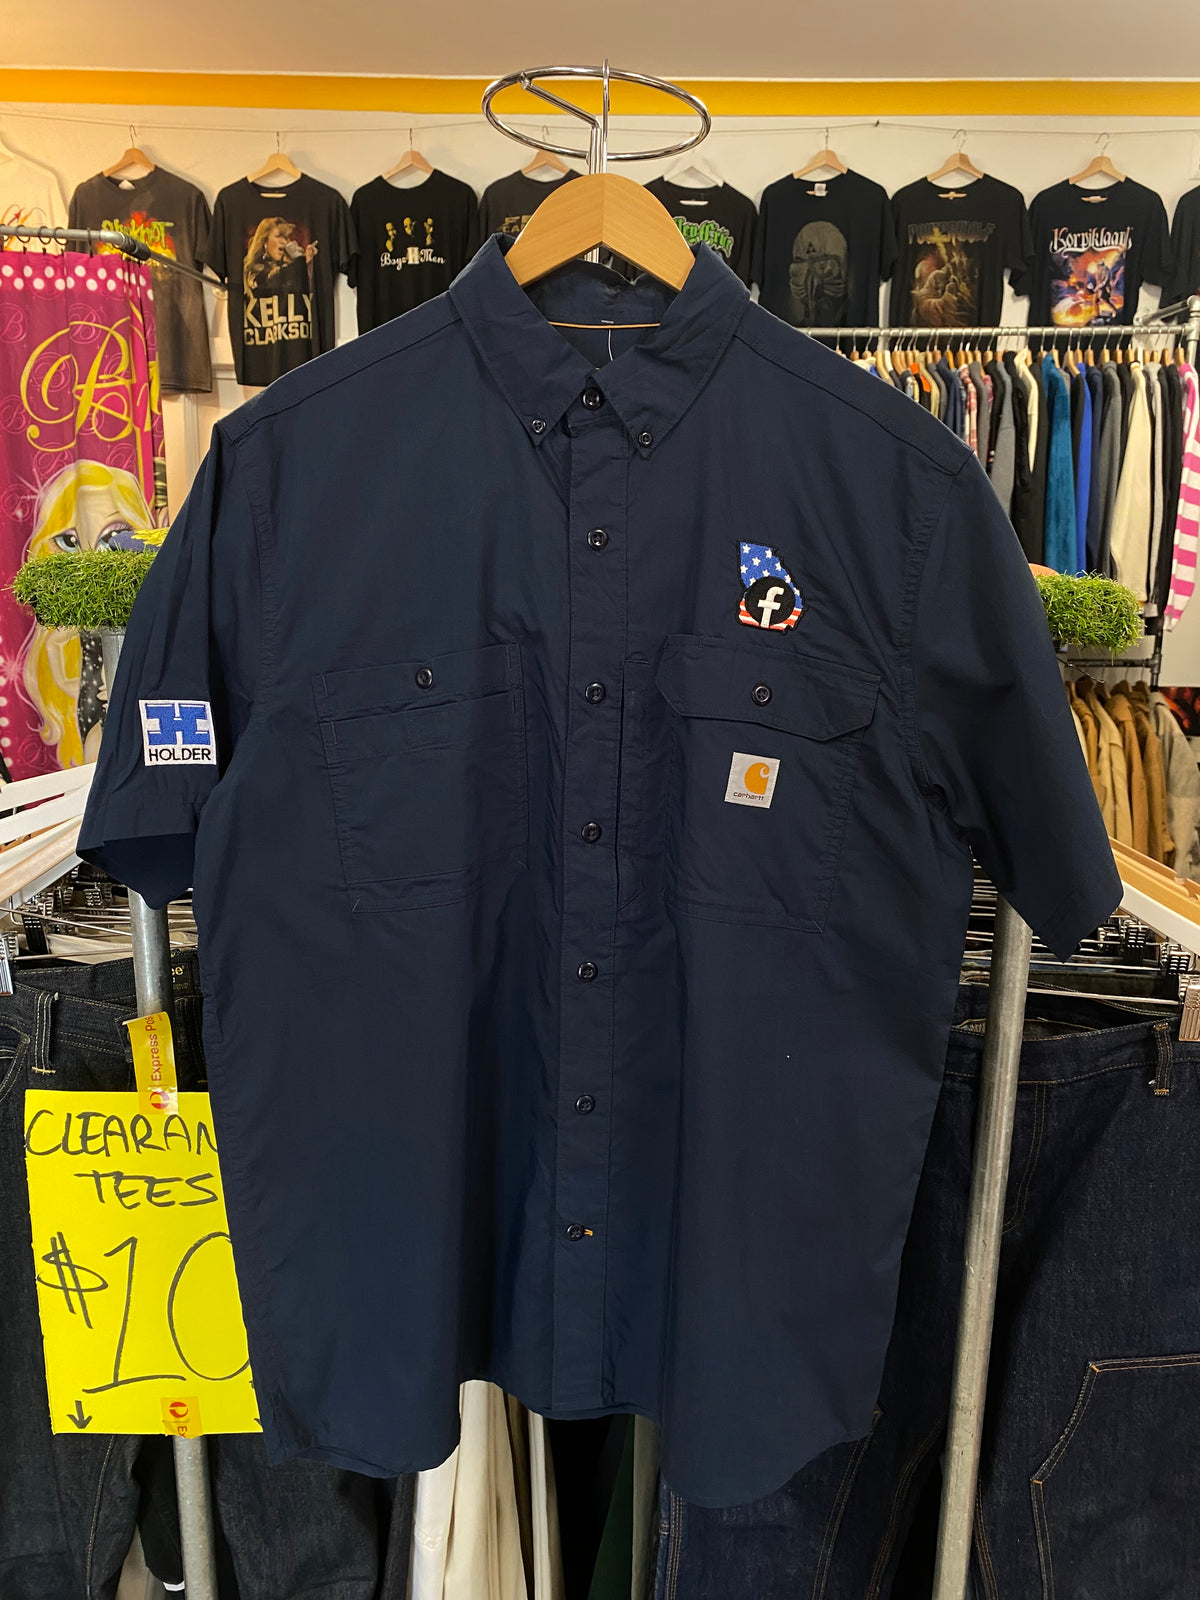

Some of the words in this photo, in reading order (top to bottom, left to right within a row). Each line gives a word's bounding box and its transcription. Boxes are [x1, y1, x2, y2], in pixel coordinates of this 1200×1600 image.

[420, 248, 445, 264] Men
[244, 293, 313, 328] KELLY
[244, 322, 313, 345] CLARKSO
[148, 747, 212, 762] HOLDER
[150, 1034, 163, 1081] Express
[75, 1169, 219, 1210] TEES
[36, 1230, 250, 1394] $10
